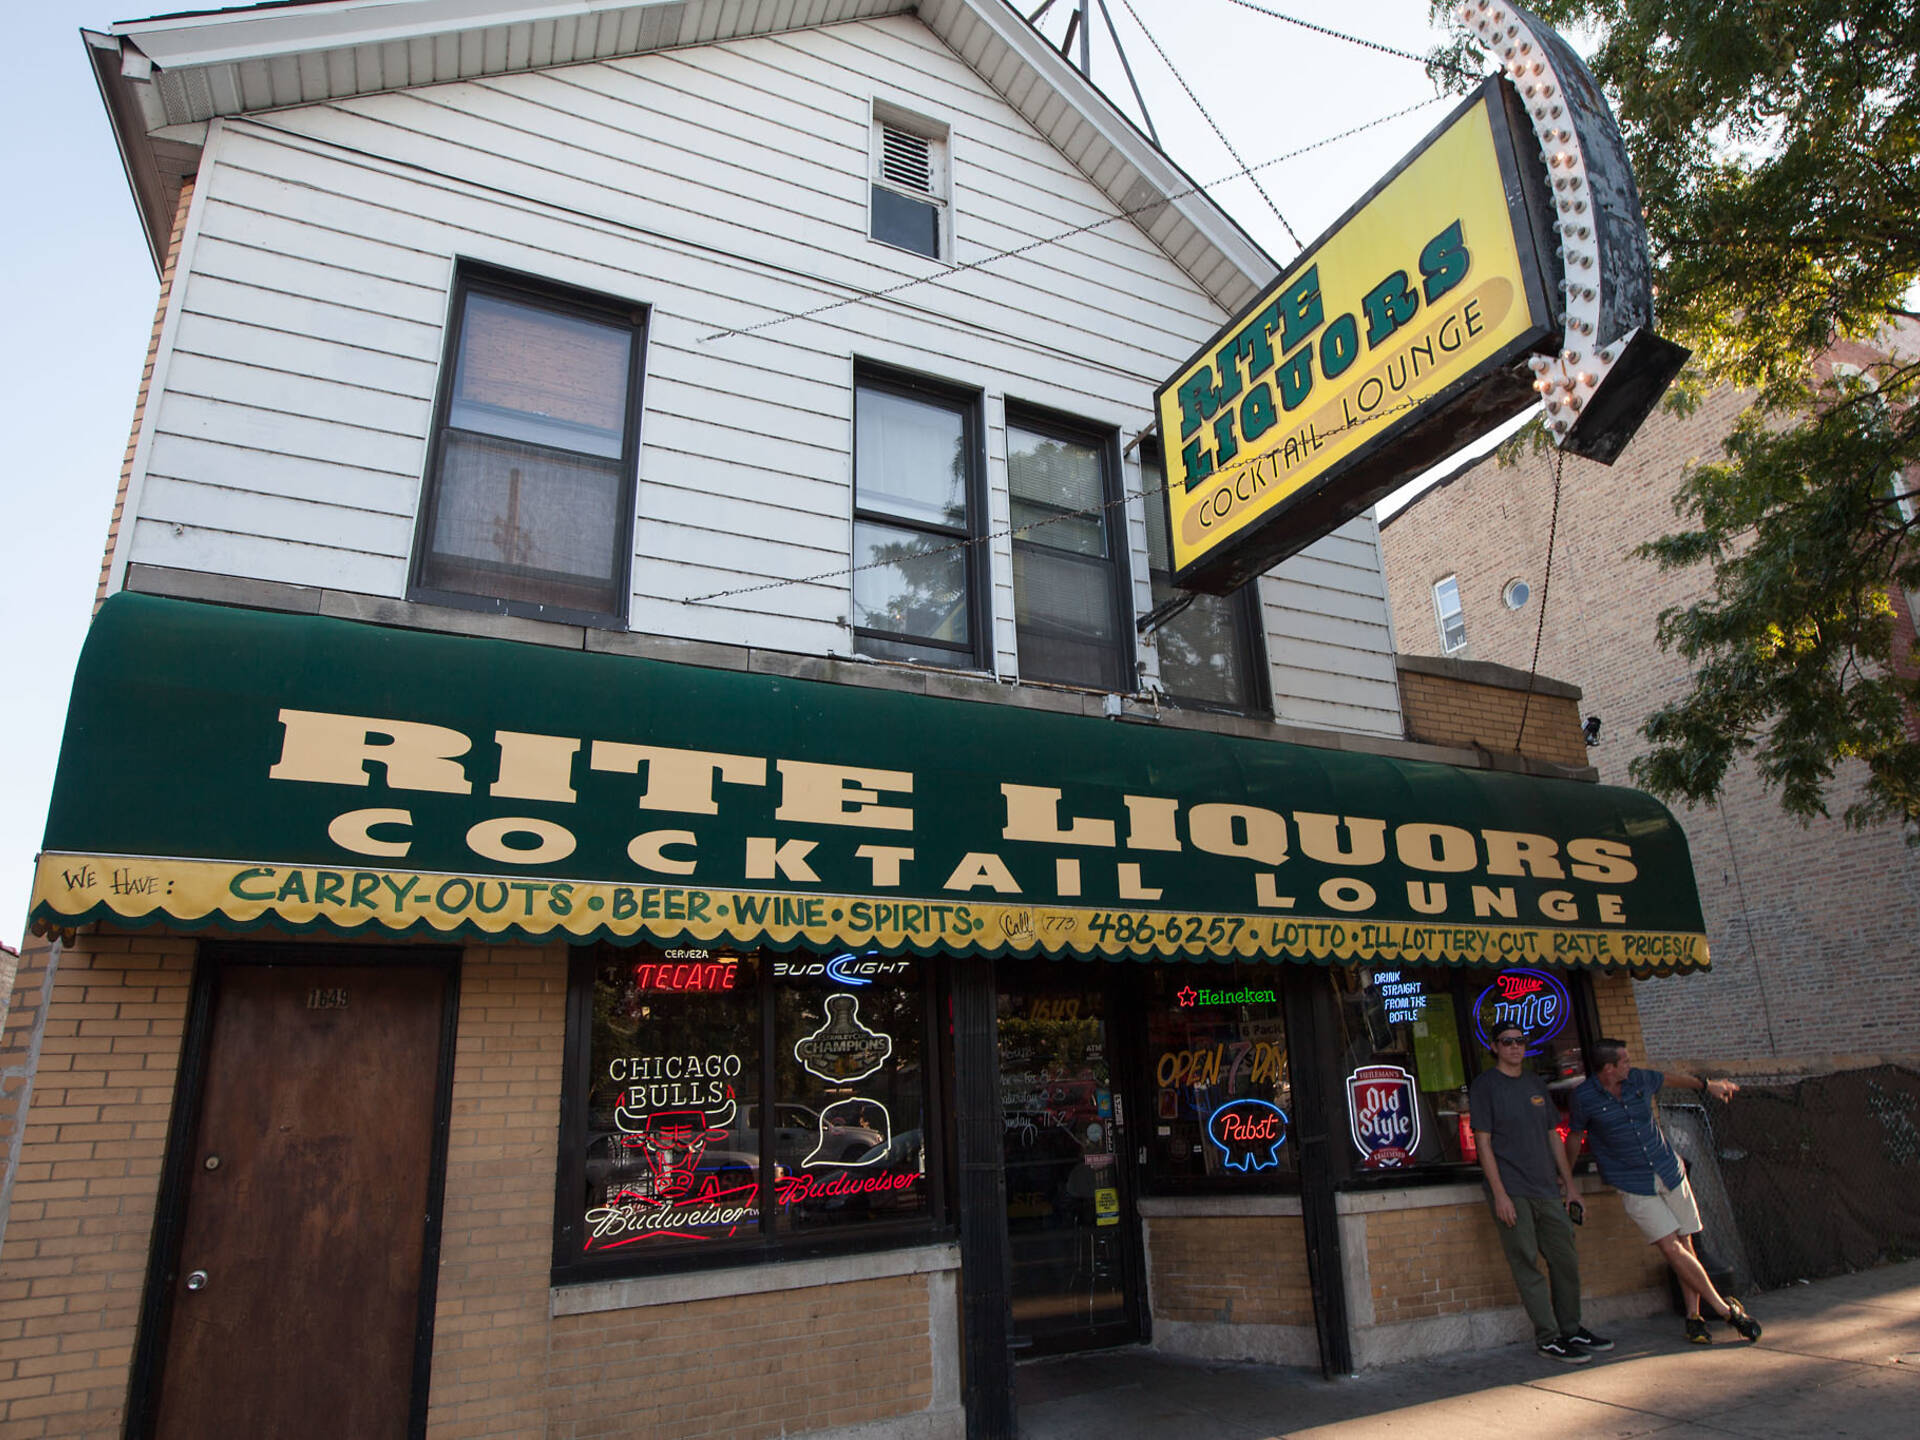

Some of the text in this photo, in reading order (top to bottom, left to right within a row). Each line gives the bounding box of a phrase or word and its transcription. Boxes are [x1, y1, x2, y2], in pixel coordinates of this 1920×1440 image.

[1177, 263, 1326, 441] RITE
[1182, 219, 1471, 494] LIQUORS
[1200, 298, 1485, 527] COCKTAIL LOUNGE
[269, 708, 1638, 883] RITE LIQUORS
[328, 807, 1627, 923] COCKTAIL LOUNGE
[62, 867, 97, 891] WE
[612, 888, 711, 922] BEER
[731, 894, 829, 928] WINE
[847, 902, 972, 936] SPIRITS
[1004, 911, 1033, 938] Call
[1088, 912, 1246, 947] 486-6257
[1271, 922, 1346, 949] LOTTO
[1402, 928, 1490, 954] LOTTERY
[1499, 932, 1539, 955] CUT
[1553, 932, 1612, 957] RATE
[665, 949, 709, 959] CERVEZA
[636, 963, 740, 989] TECATE
[773, 961, 911, 977] BUD LIGHT
[1374, 971, 1401, 984] DRINK
[309, 988, 350, 1009] 1649
[1198, 987, 1277, 1006] Heineken
[1382, 982, 1421, 997] STRAIGHT
[1497, 976, 1544, 997] Miller
[1384, 995, 1427, 1010] FROM THE
[1389, 1009, 1418, 1024] BOTTLE
[804, 1038, 886, 1054] CHAMPIONS
[609, 1055, 741, 1081] CHICAGO
[1157, 1042, 1224, 1088] OPEN
[1228, 1041, 1252, 1095] 7
[629, 1081, 724, 1109] BULLS
[1366, 1087, 1400, 1113] Old
[1221, 1114, 1279, 1140] Pabst
[1359, 1108, 1409, 1145] Style
[774, 1169, 921, 1205] Budweiser
[585, 1203, 747, 1238] Budweiser
